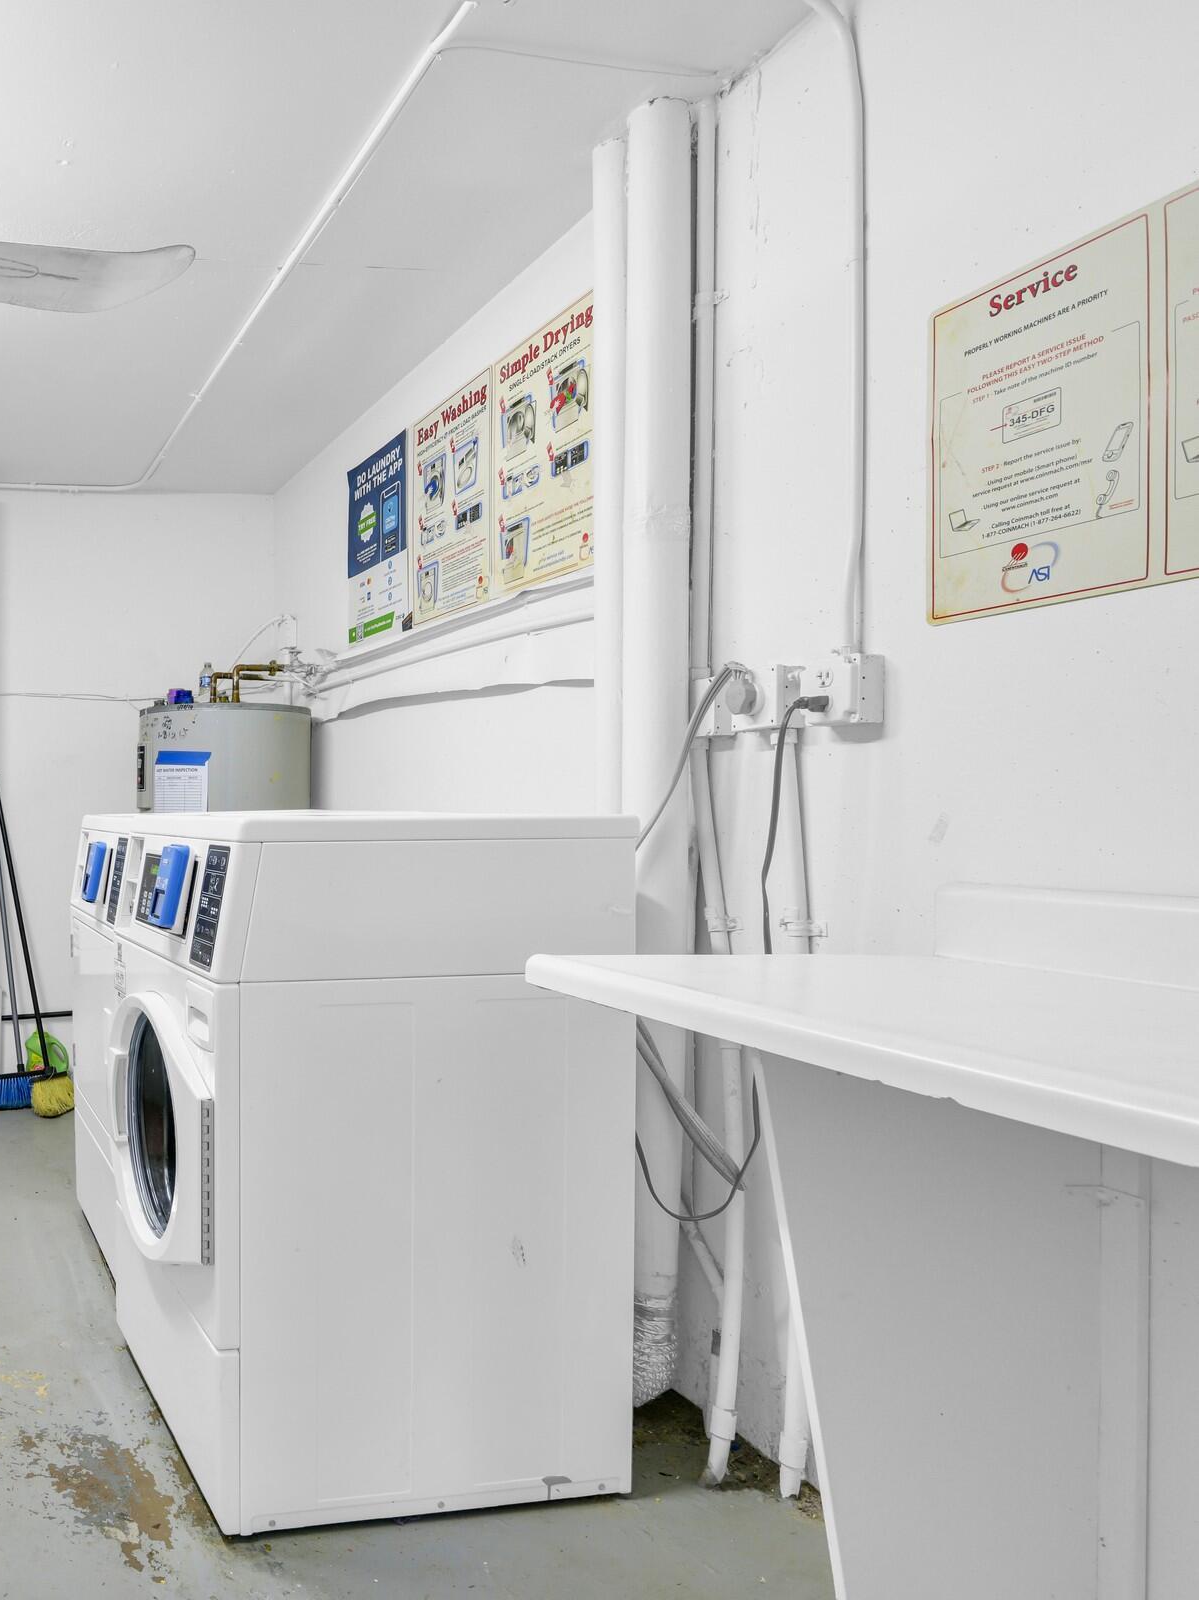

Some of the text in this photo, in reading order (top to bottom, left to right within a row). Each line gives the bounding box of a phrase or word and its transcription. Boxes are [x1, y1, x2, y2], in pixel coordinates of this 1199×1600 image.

[989, 264, 1078, 317] Service
[964, 341, 993, 358] PROPERLY
[994, 326, 1022, 345] WORKING
[1024, 312, 1056, 332] MACHINES
[1058, 308, 1070, 316] ARE
[1077, 289, 1108, 308] PRIORITY
[500, 304, 593, 384] Simple Drying
[558, 336, 580, 357] DRYERS
[982, 366, 1004, 380] PLEASE
[1005, 356, 1030, 374] REPORT
[1037, 344, 1064, 358] SERVICE
[1066, 334, 1086, 347] ISSUE
[967, 336, 1104, 395] FOLLOWING THIS EASY TWO-STEP METHOD
[994, 388, 1006, 396] Take
[1007, 382, 1020, 390] note
[1028, 375, 1038, 384] the
[1038, 364, 1064, 380] machine
[1064, 361, 1072, 369] ID
[1072, 352, 1098, 366] number
[416, 420, 440, 446] Easy
[441, 384, 488, 428] Washing
[1009, 404, 1055, 427] 345-DFG
[356, 472, 366, 488] DO
[367, 445, 401, 480] LAUNDRY
[981, 464, 995, 474] STEP
[1004, 456, 1023, 467] Report
[1024, 452, 1034, 460] the
[1034, 446, 1054, 456] service
[1056, 442, 1070, 450] issue
[987, 478, 1003, 486] Using
[1014, 468, 1034, 478] mobile
[1034, 460, 1054, 472] (Smart
[1056, 454, 1078, 467] phone)
[354, 458, 403, 502] WITH THE APP
[972, 490, 991, 498] service
[992, 482, 1012, 494] request
[983, 502, 999, 511] Using
[1000, 498, 1010, 506] our
[1010, 492, 1028, 504] online
[1028, 488, 1050, 498] service
[1050, 480, 1073, 493] request
[991, 520, 1010, 530] Calling
[1011, 510, 1040, 524] Coinmach
[1040, 506, 1050, 517] toll
[1051, 505, 1064, 514] free
[1002, 492, 1058, 512] www.coinmach.com
[982, 520, 1030, 539] 1-877-COINMACH
